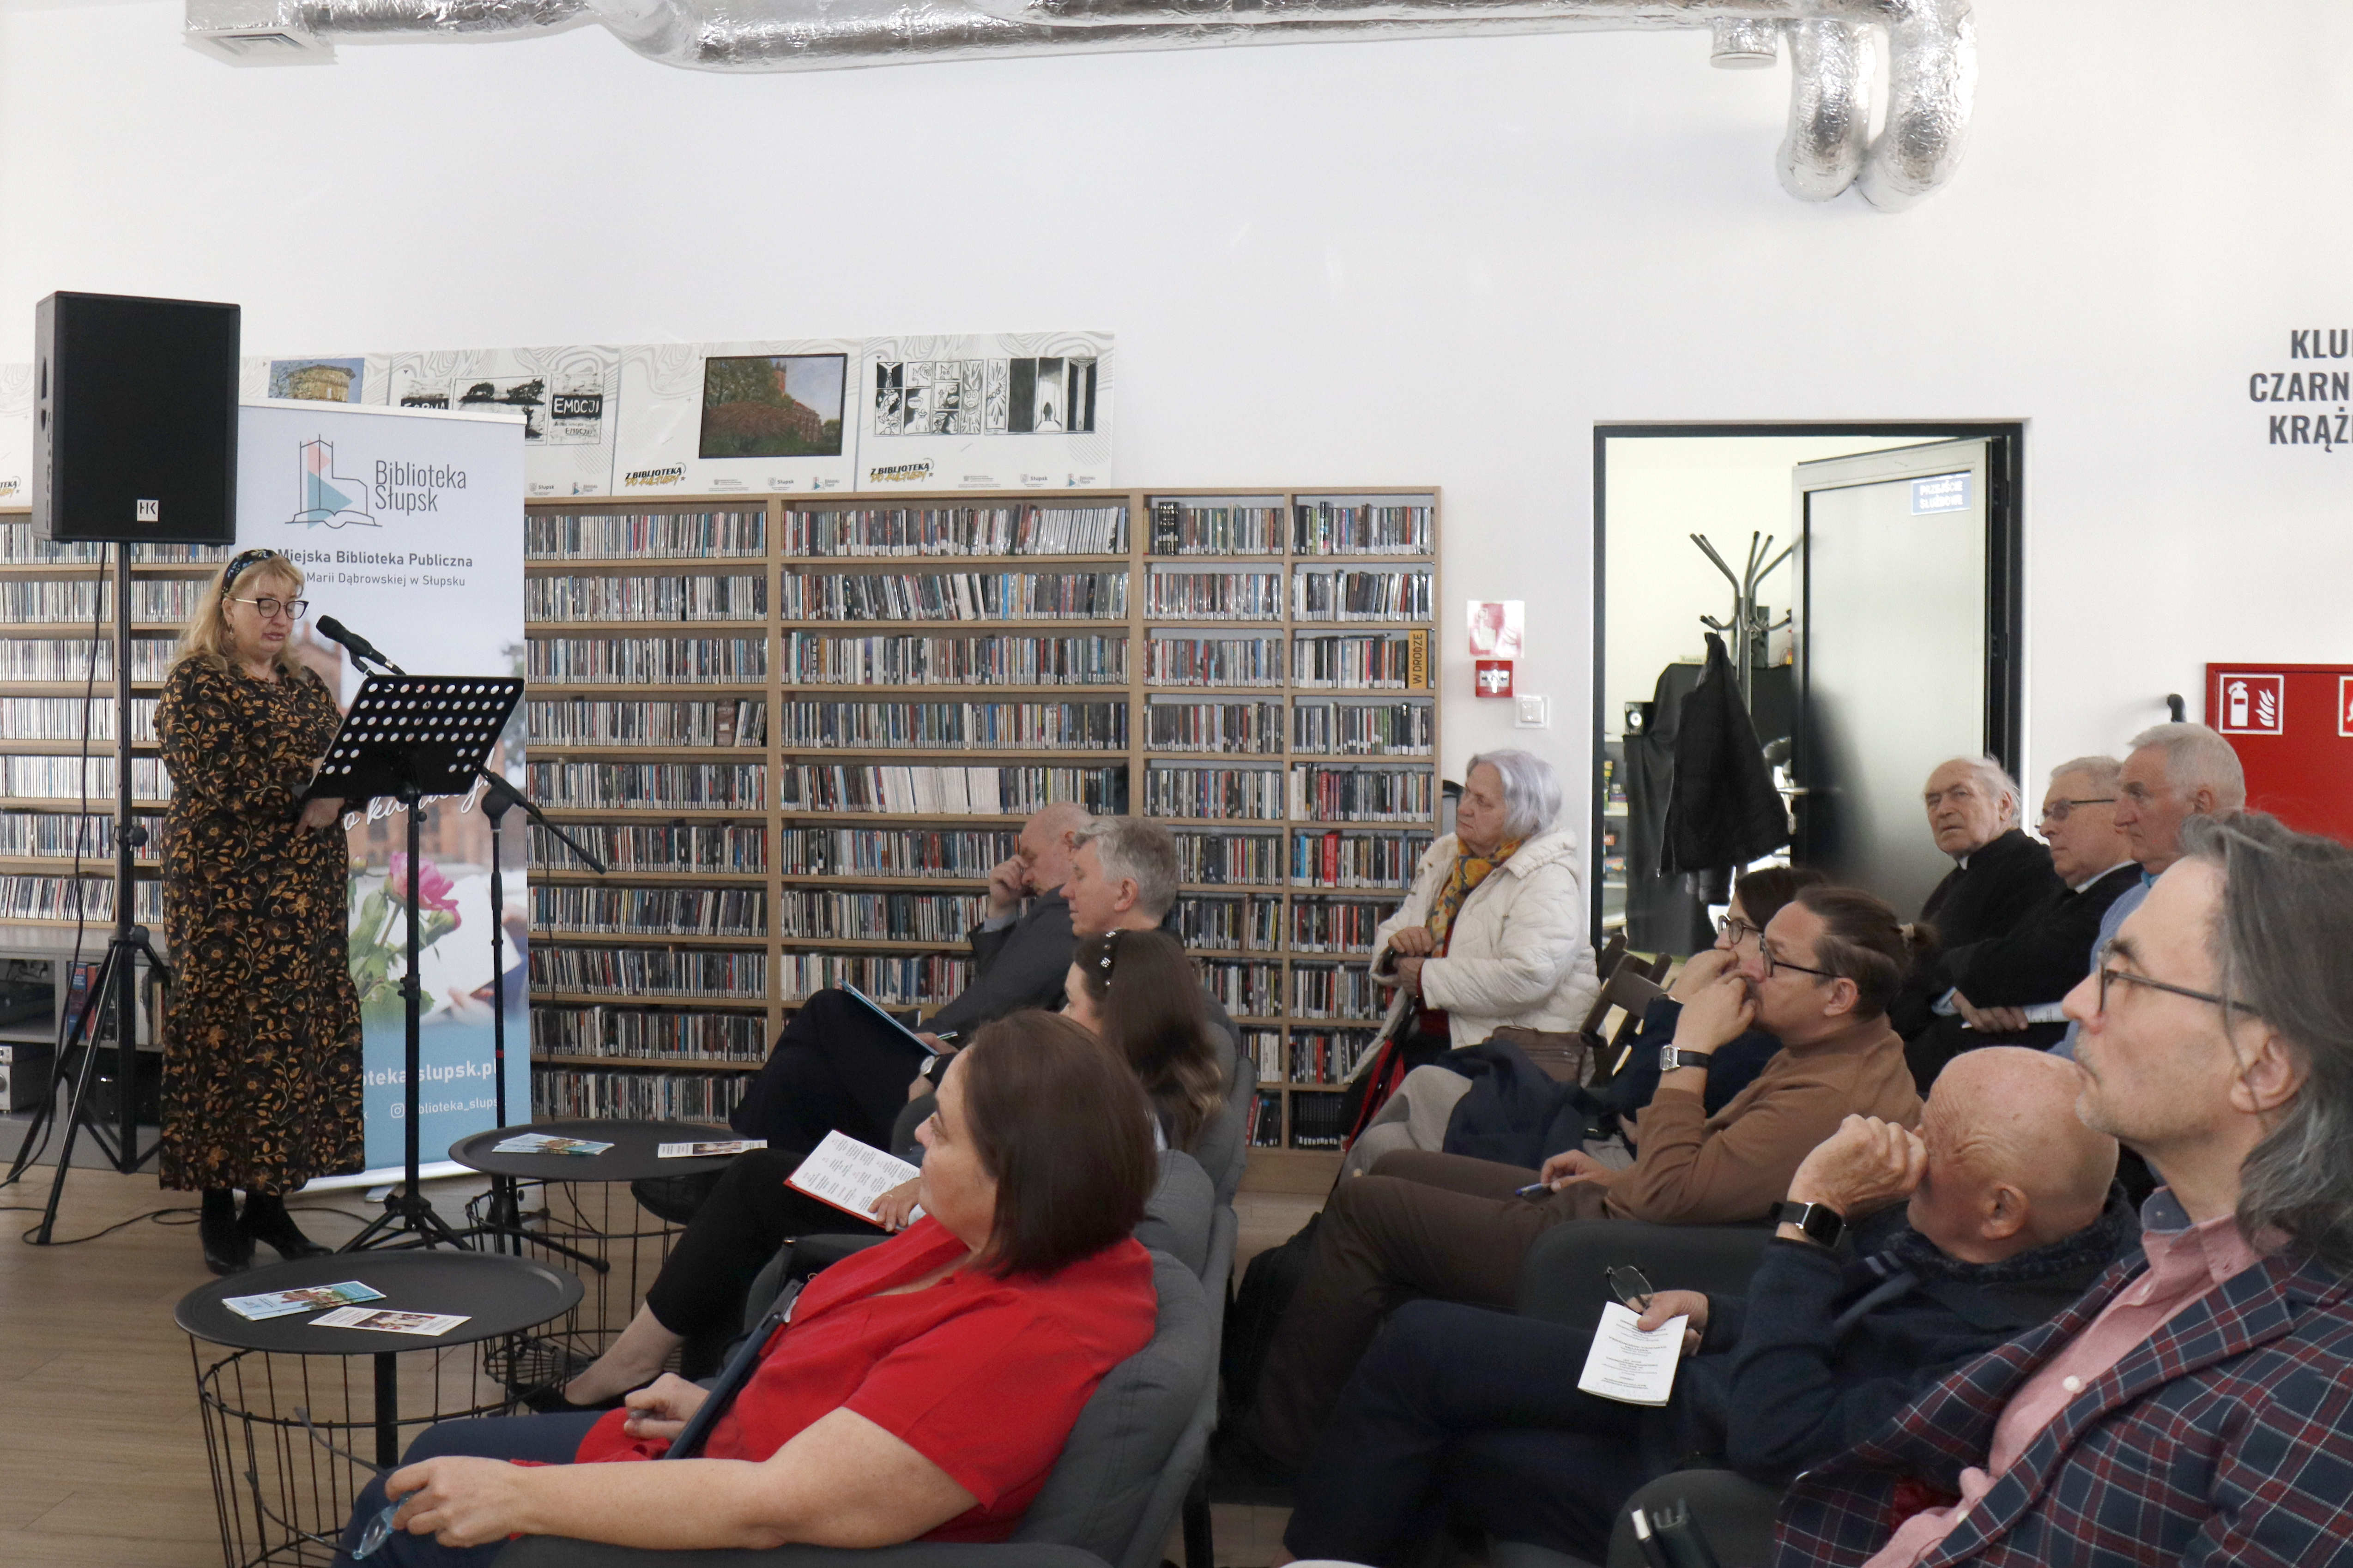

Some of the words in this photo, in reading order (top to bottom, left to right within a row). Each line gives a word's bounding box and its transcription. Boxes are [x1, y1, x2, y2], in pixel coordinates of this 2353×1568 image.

[2291, 329, 2353, 359] KLU
[554, 398, 599, 414] EMOCJI
[2269, 407, 2353, 453] KRĄŻ
[376, 460, 466, 489] Biblioteka
[140, 502, 156, 514] HK
[375, 485, 438, 516] Słupsk
[278, 549, 331, 565] Miejska
[336, 550, 404, 565] Biblioteka
[409, 553, 472, 567] Publiczna
[307, 572, 334, 583] Marii
[339, 573, 406, 587] Dąbrowskiej
[410, 576, 418, 585] w
[423, 575, 465, 587] Słupsku
[1413, 633, 1422, 672] DRODZE
[1413, 674, 1422, 684] W
